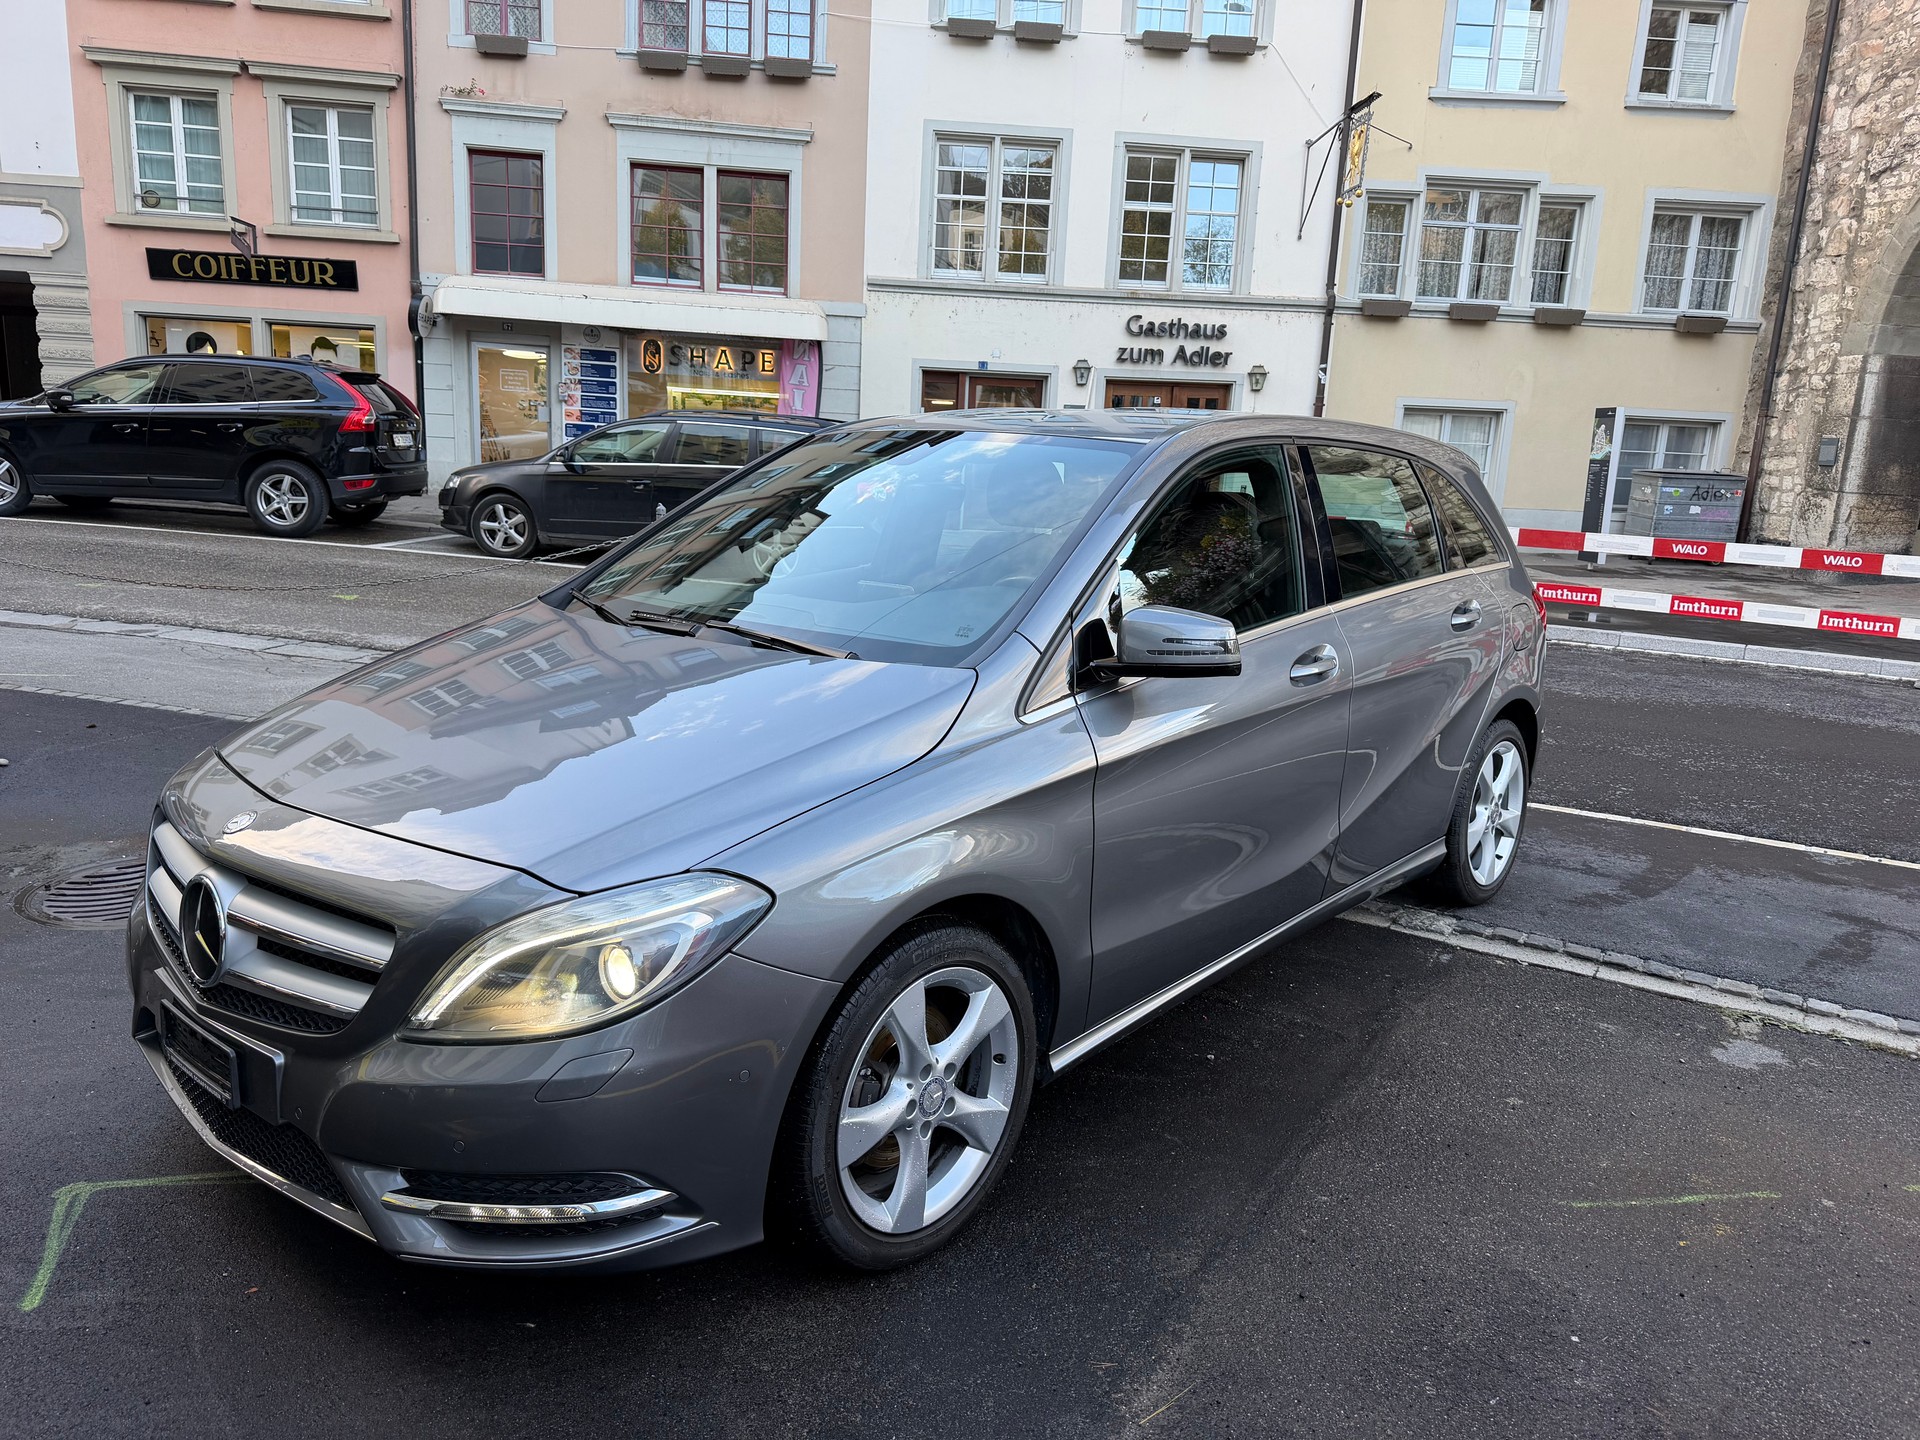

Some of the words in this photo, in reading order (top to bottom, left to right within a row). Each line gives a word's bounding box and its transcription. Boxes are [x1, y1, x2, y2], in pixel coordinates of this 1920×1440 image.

[172, 252, 337, 286] COIFFEUR
[1125, 314, 1228, 339] Gasthaus
[668, 344, 776, 374] SHAPE
[1116, 347, 1164, 364] zum
[1171, 344, 1233, 367] Adler
[1671, 543, 1708, 556] WALO
[1823, 554, 1863, 568] WALO
[1538, 587, 1598, 603] Imthurn
[1672, 599, 1739, 617] Imthurn
[1821, 614, 1895, 633] Imthurn
